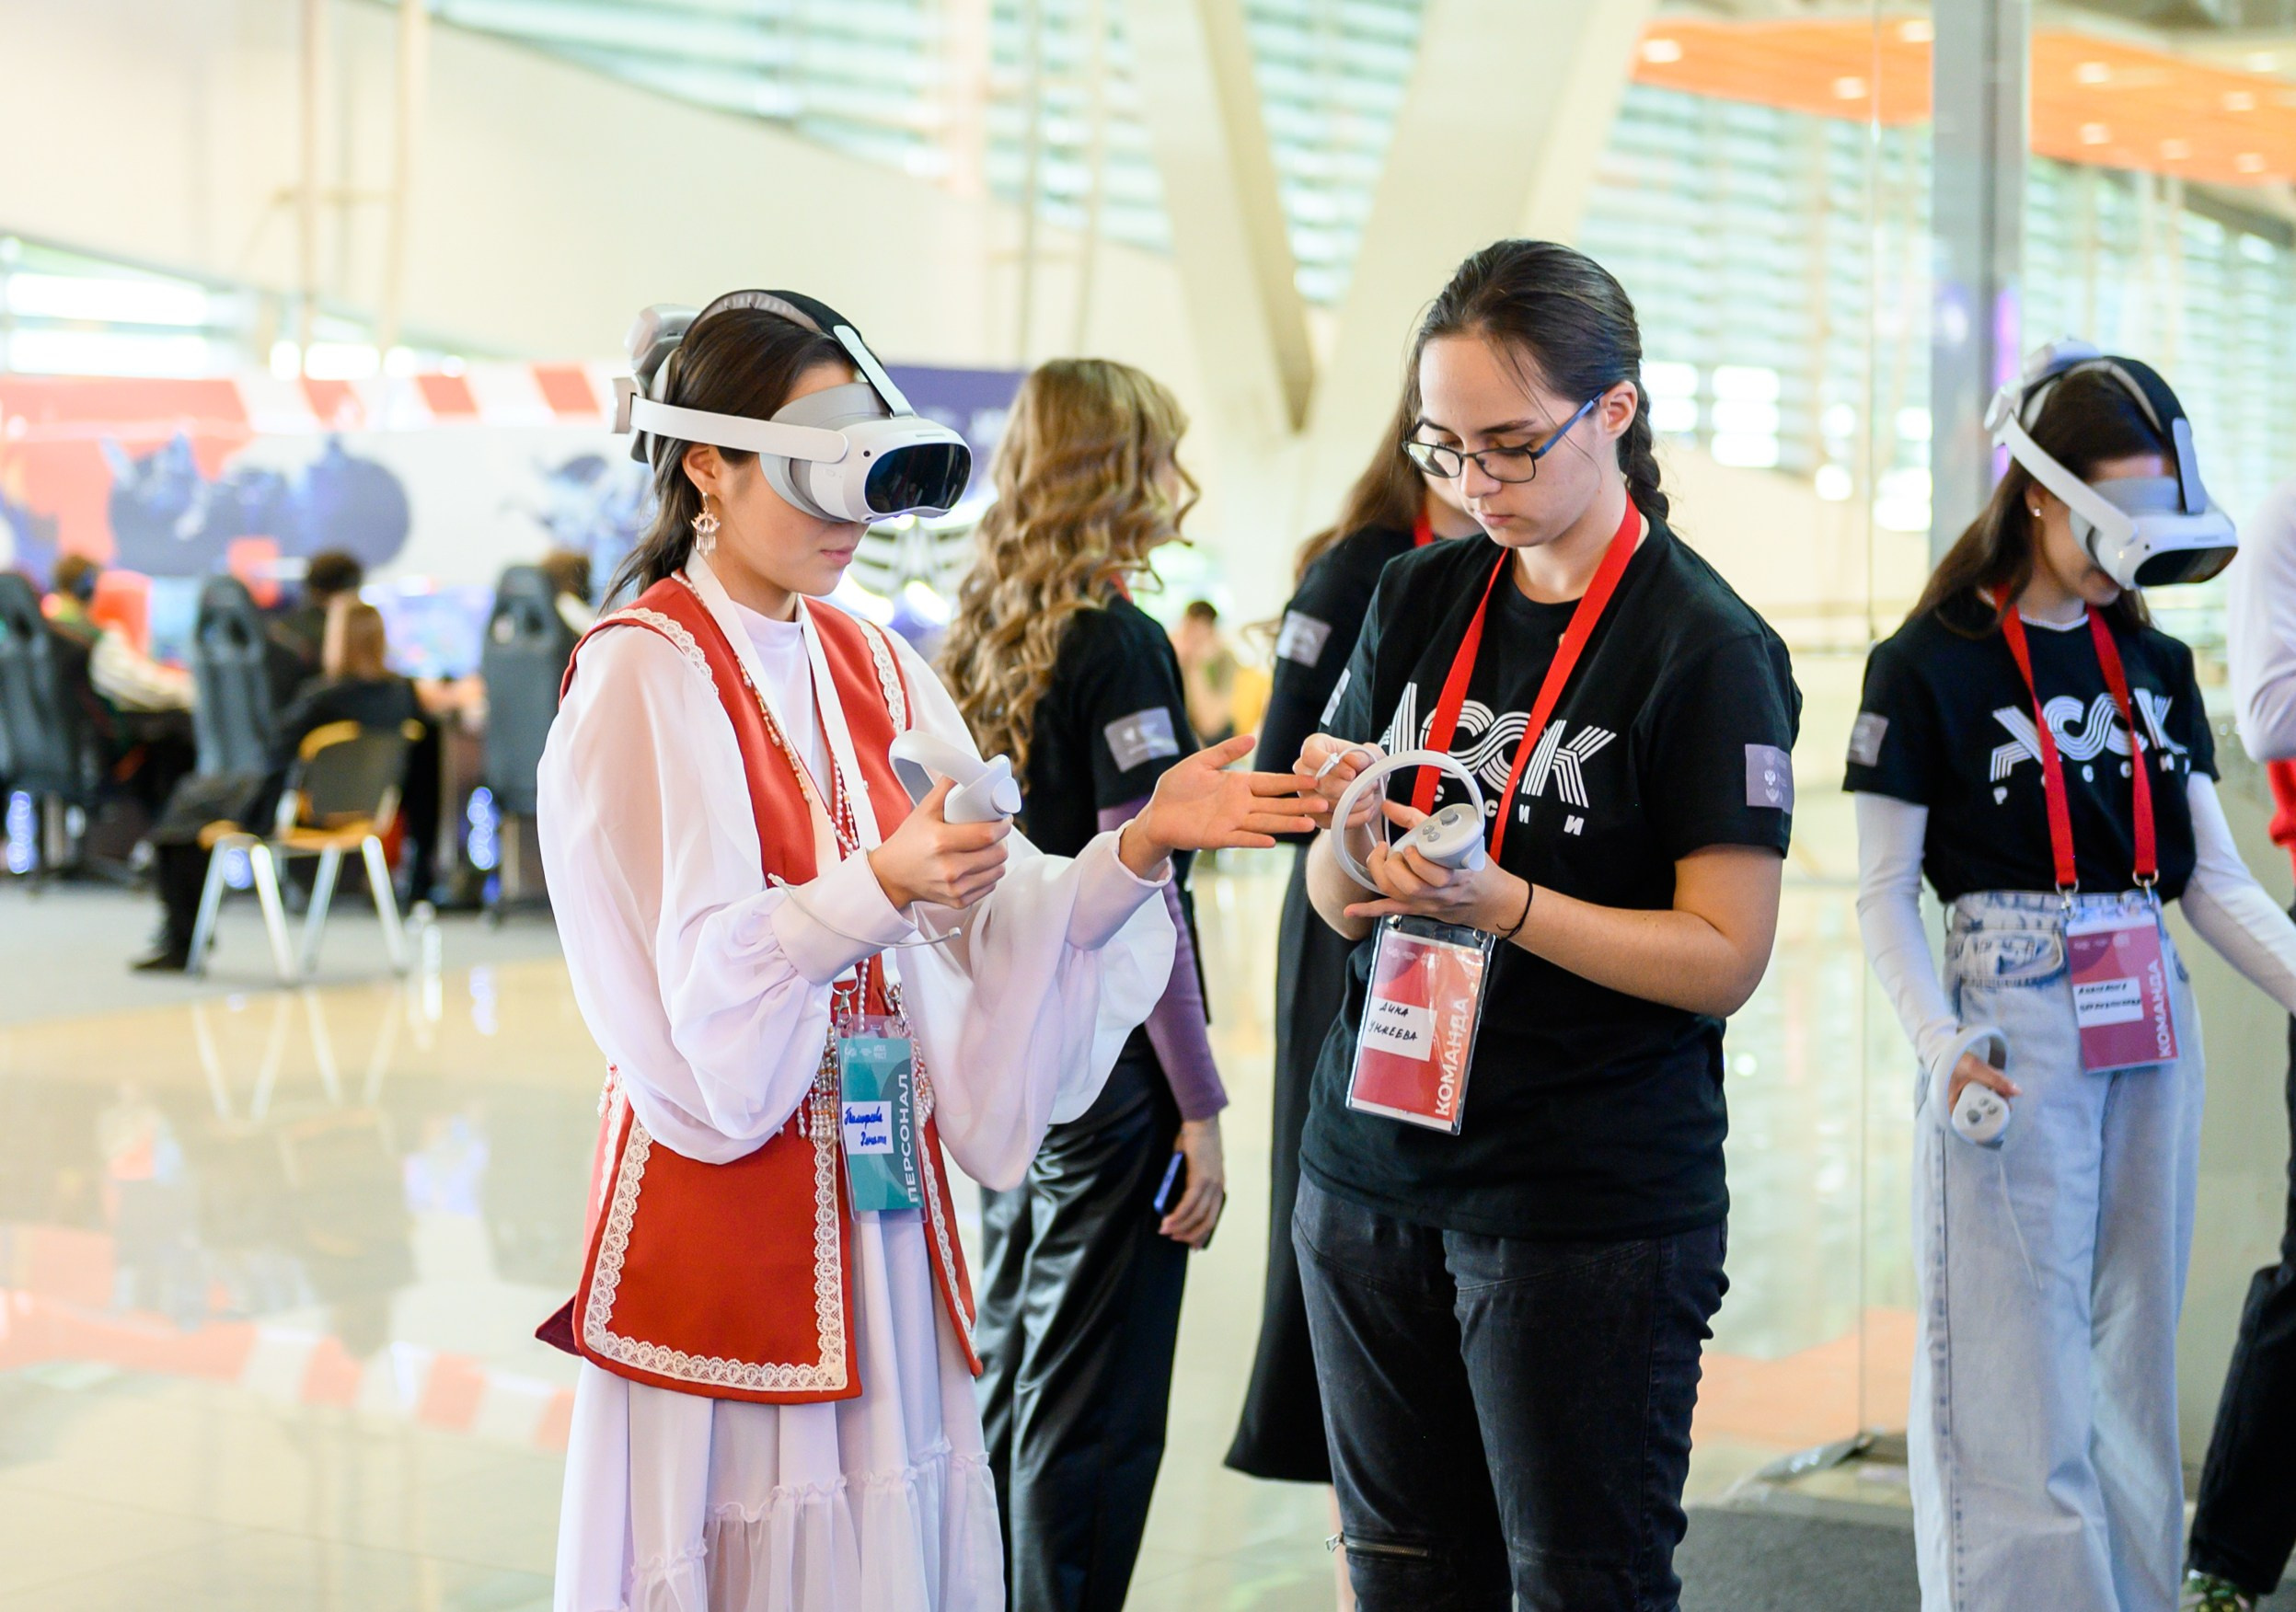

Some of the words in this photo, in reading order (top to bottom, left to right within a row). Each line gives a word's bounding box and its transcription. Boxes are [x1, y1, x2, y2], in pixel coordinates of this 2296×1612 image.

[1435, 998, 1470, 1116] КОМАНДА
[2148, 959, 2172, 1057] КОМАНДА
[898, 1074, 918, 1203] ПЕРСОНАЛ
